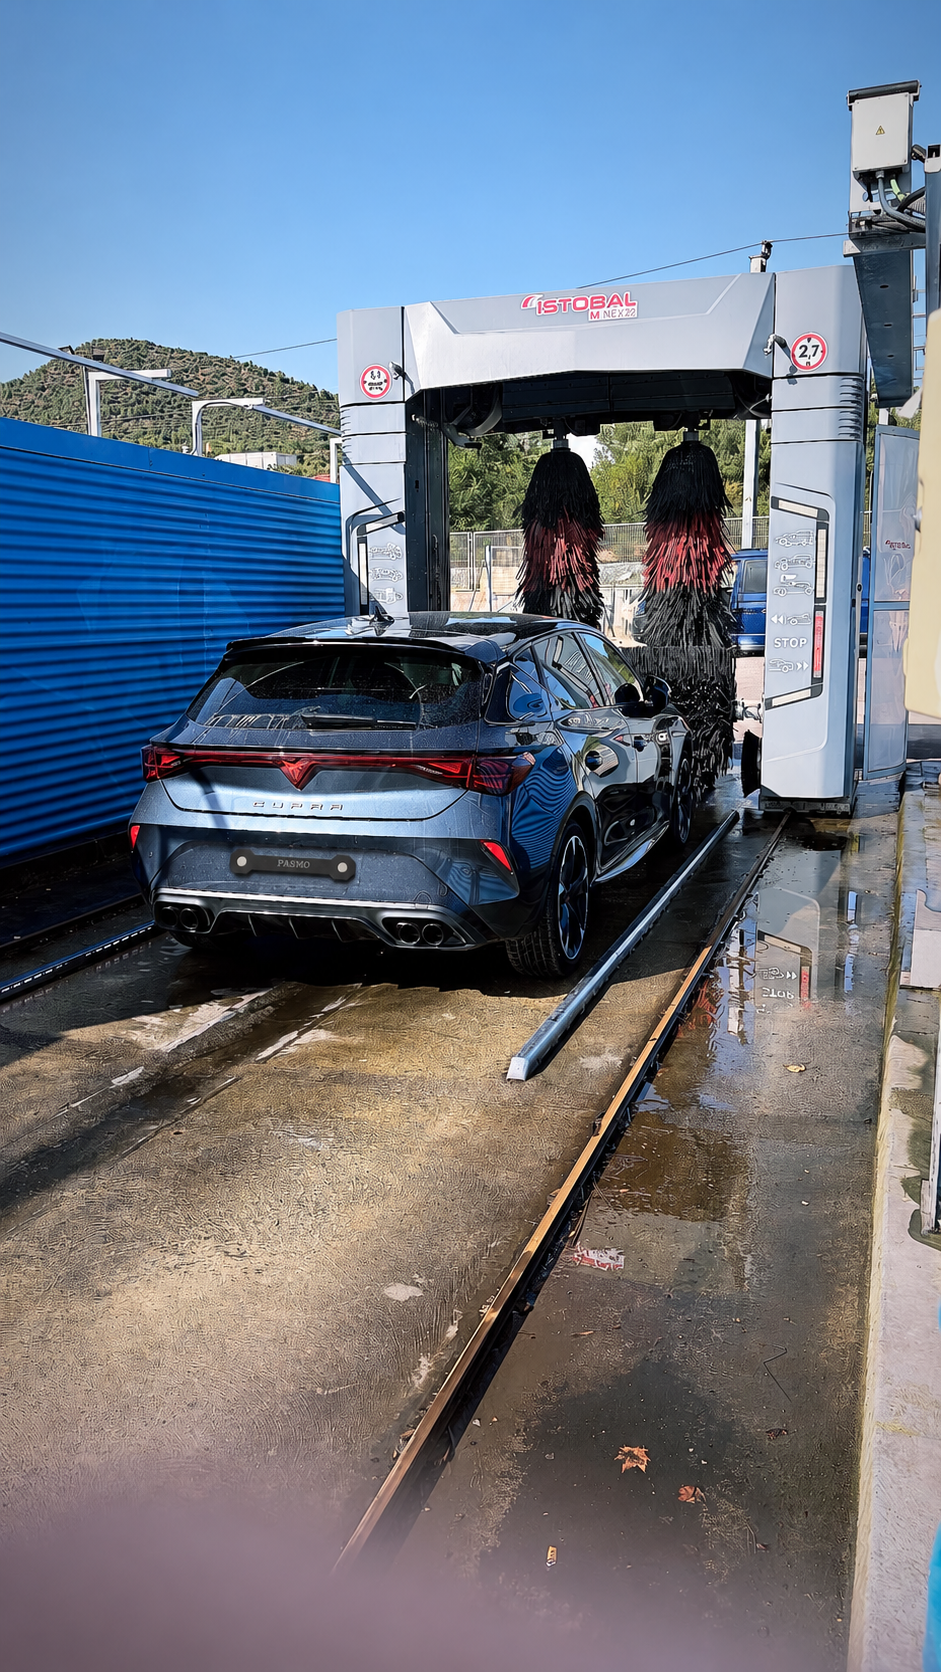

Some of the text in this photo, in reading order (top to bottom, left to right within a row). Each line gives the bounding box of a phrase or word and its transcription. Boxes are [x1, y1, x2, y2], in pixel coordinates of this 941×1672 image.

[537, 292, 637, 315] ISTOBAL
[798, 344, 820, 360] 2,7
[774, 638, 807, 648] STOP
[252, 801, 344, 811] CUPRA
[276, 859, 311, 869] PASMO
